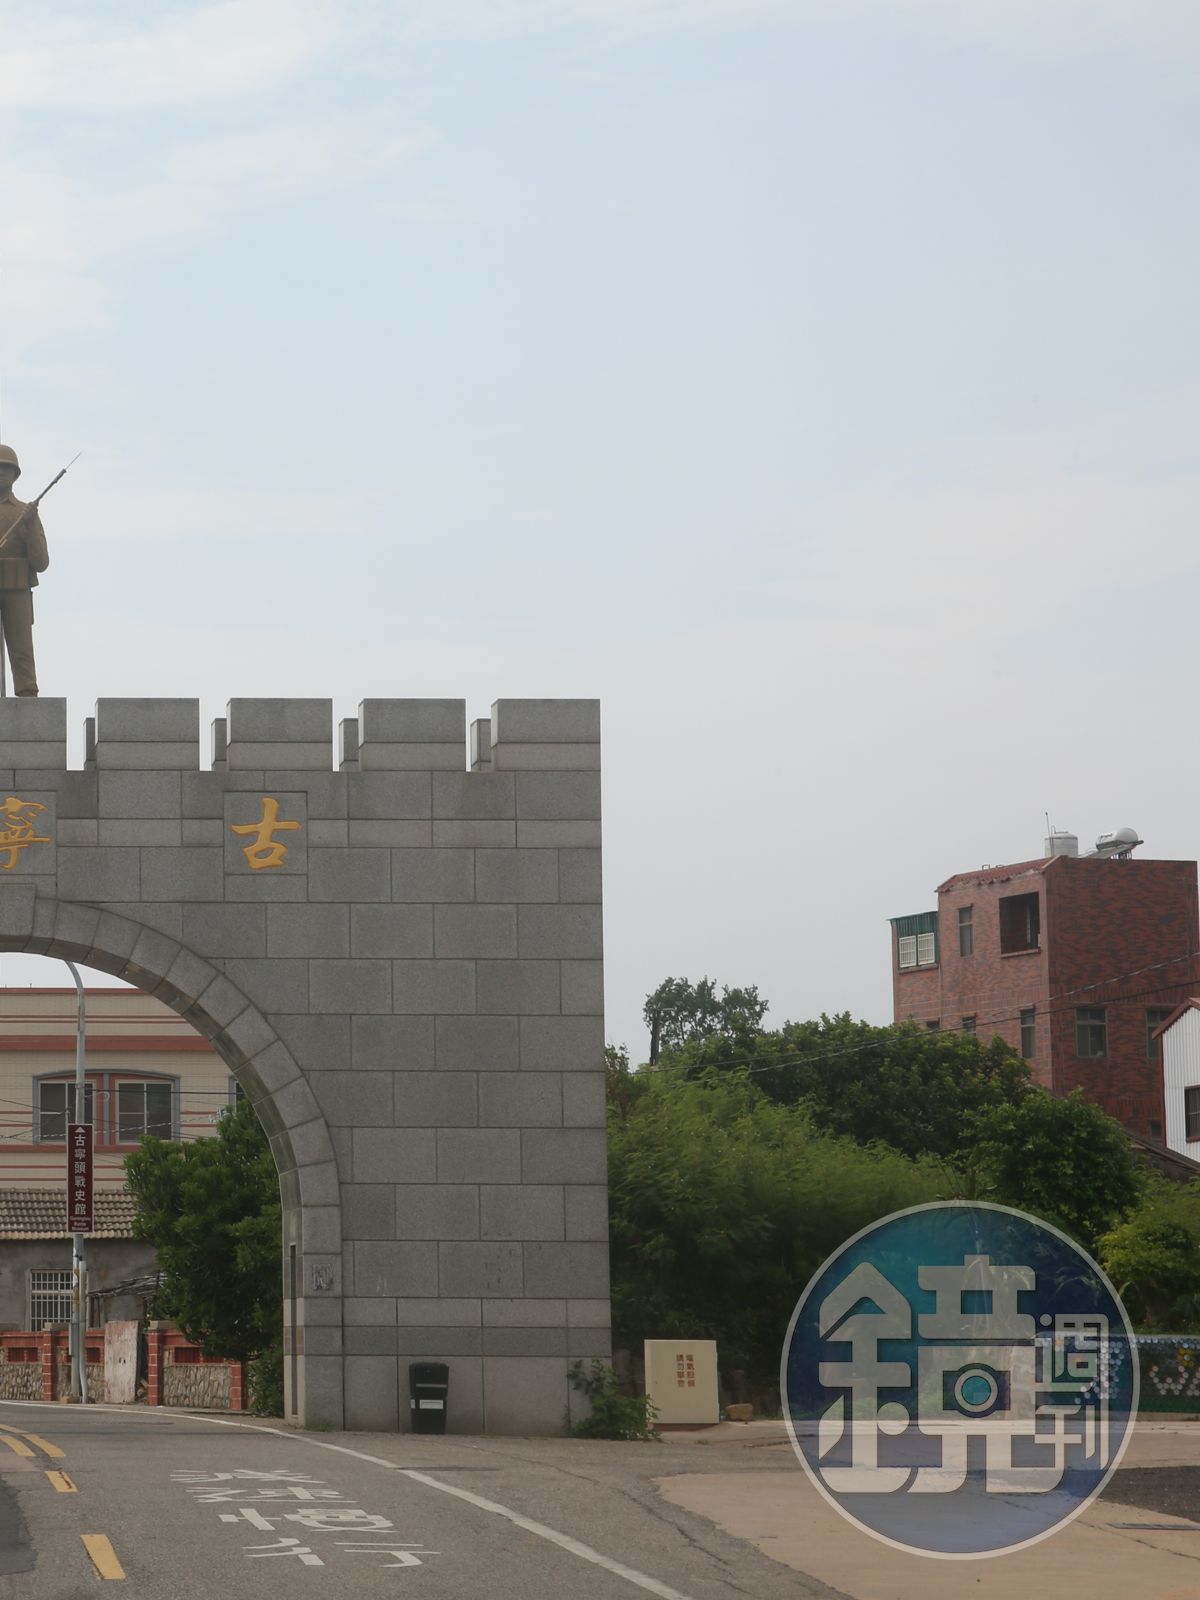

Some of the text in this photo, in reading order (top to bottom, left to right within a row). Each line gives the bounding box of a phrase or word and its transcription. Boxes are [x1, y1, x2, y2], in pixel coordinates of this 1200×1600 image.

[74, 1134, 87, 1215] 古寧頭戰史館
[169, 1469, 441, 1568] 減速慢行
